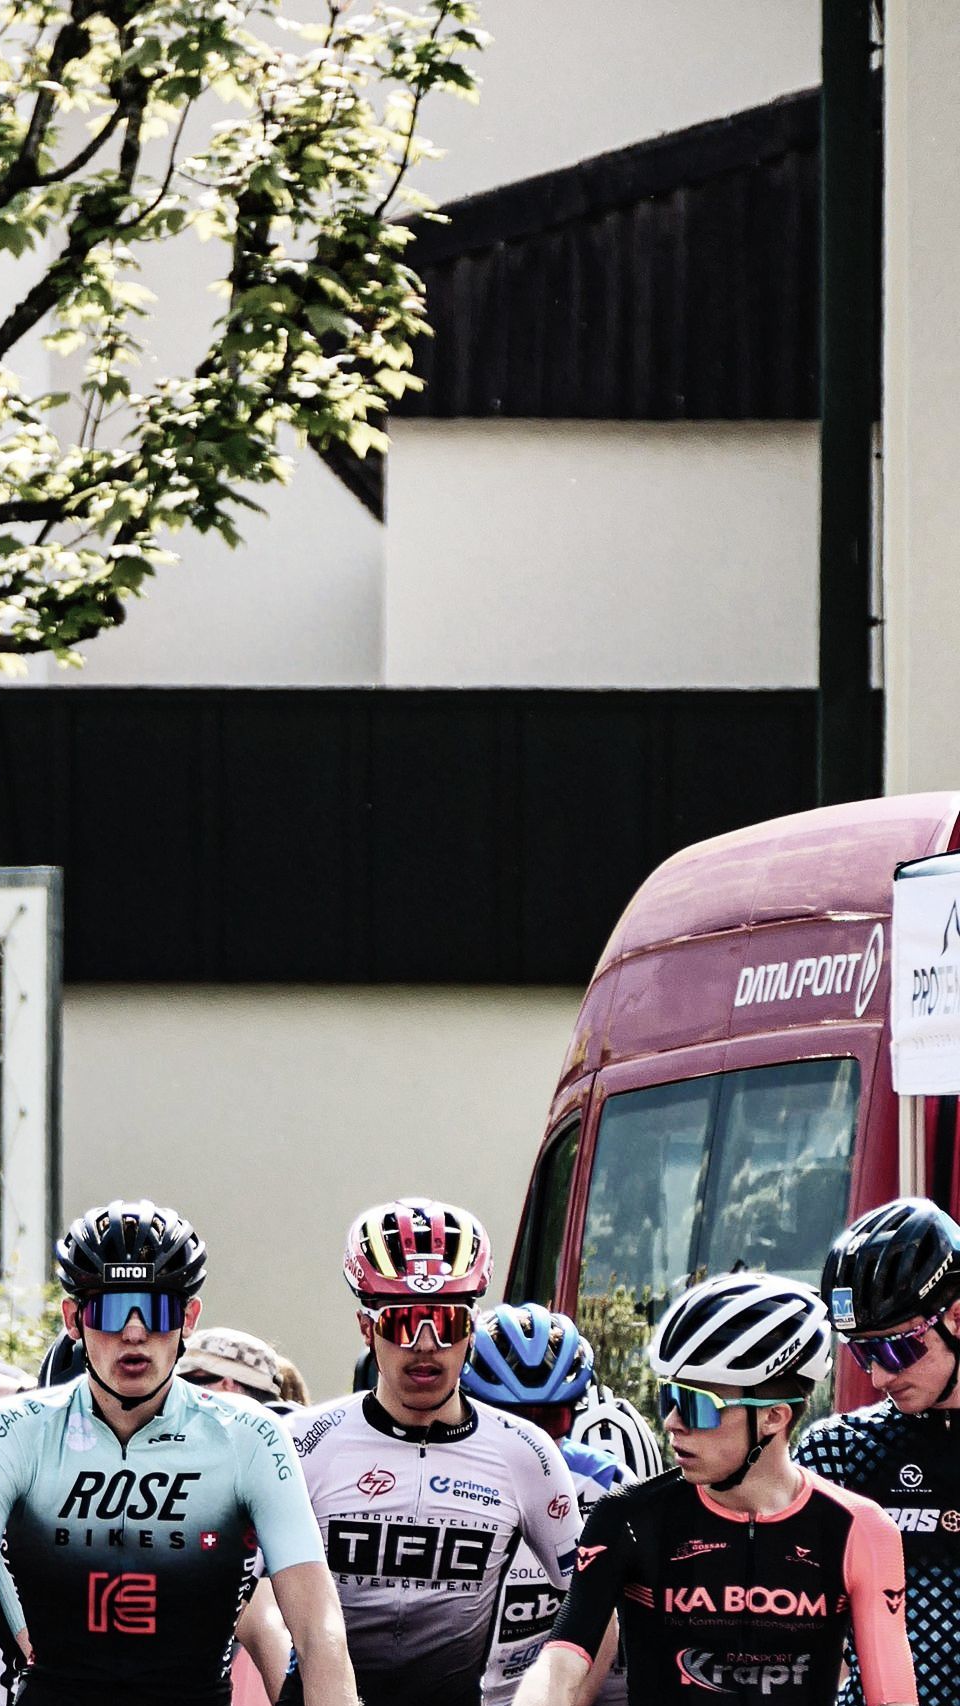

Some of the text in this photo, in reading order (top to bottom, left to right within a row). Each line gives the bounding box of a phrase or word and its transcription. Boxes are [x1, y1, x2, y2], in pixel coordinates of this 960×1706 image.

[734, 952, 863, 1008] DATASPORT
[918, 1249, 954, 1300] SCOTT
[765, 1337, 803, 1376] LAZER
[516, 1429, 552, 1477] vaudoise
[58, 1468, 202, 1522] ROSE
[452, 1489, 502, 1507] energie
[453, 1479, 500, 1497] primeo
[54, 1527, 186, 1551] BIKES
[427, 1517, 500, 1532] CYCLING
[338, 1531, 484, 1571] TFC
[692, 1542, 728, 1551] GOSSAU
[339, 1574, 485, 1593] EVELOPMENT
[665, 1585, 828, 1617] KA BOOM
[676, 1648, 811, 1695] Krapf
